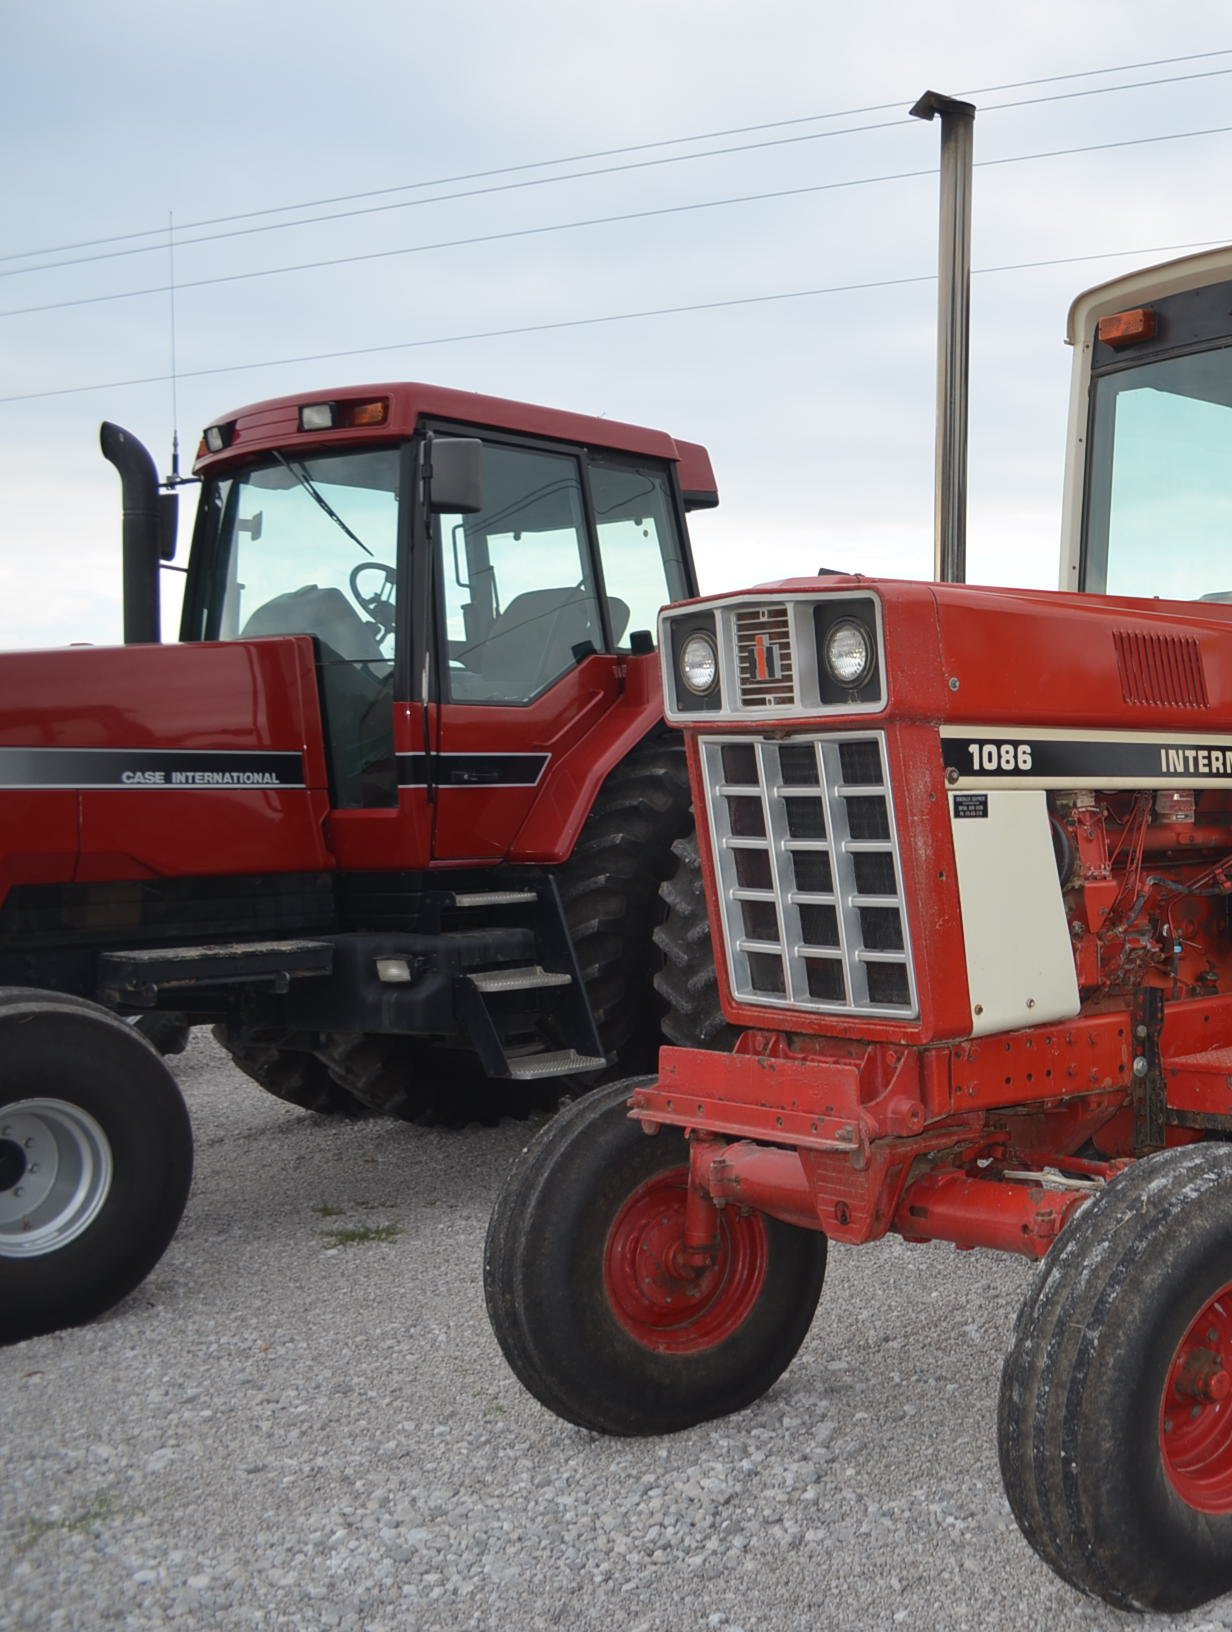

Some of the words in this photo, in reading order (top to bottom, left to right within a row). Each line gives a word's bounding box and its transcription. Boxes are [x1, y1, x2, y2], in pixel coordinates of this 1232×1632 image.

[968, 743, 1033, 771] 1086
[121, 771, 165, 784] CASE
[171, 771, 281, 784] INTERNATIONAL
